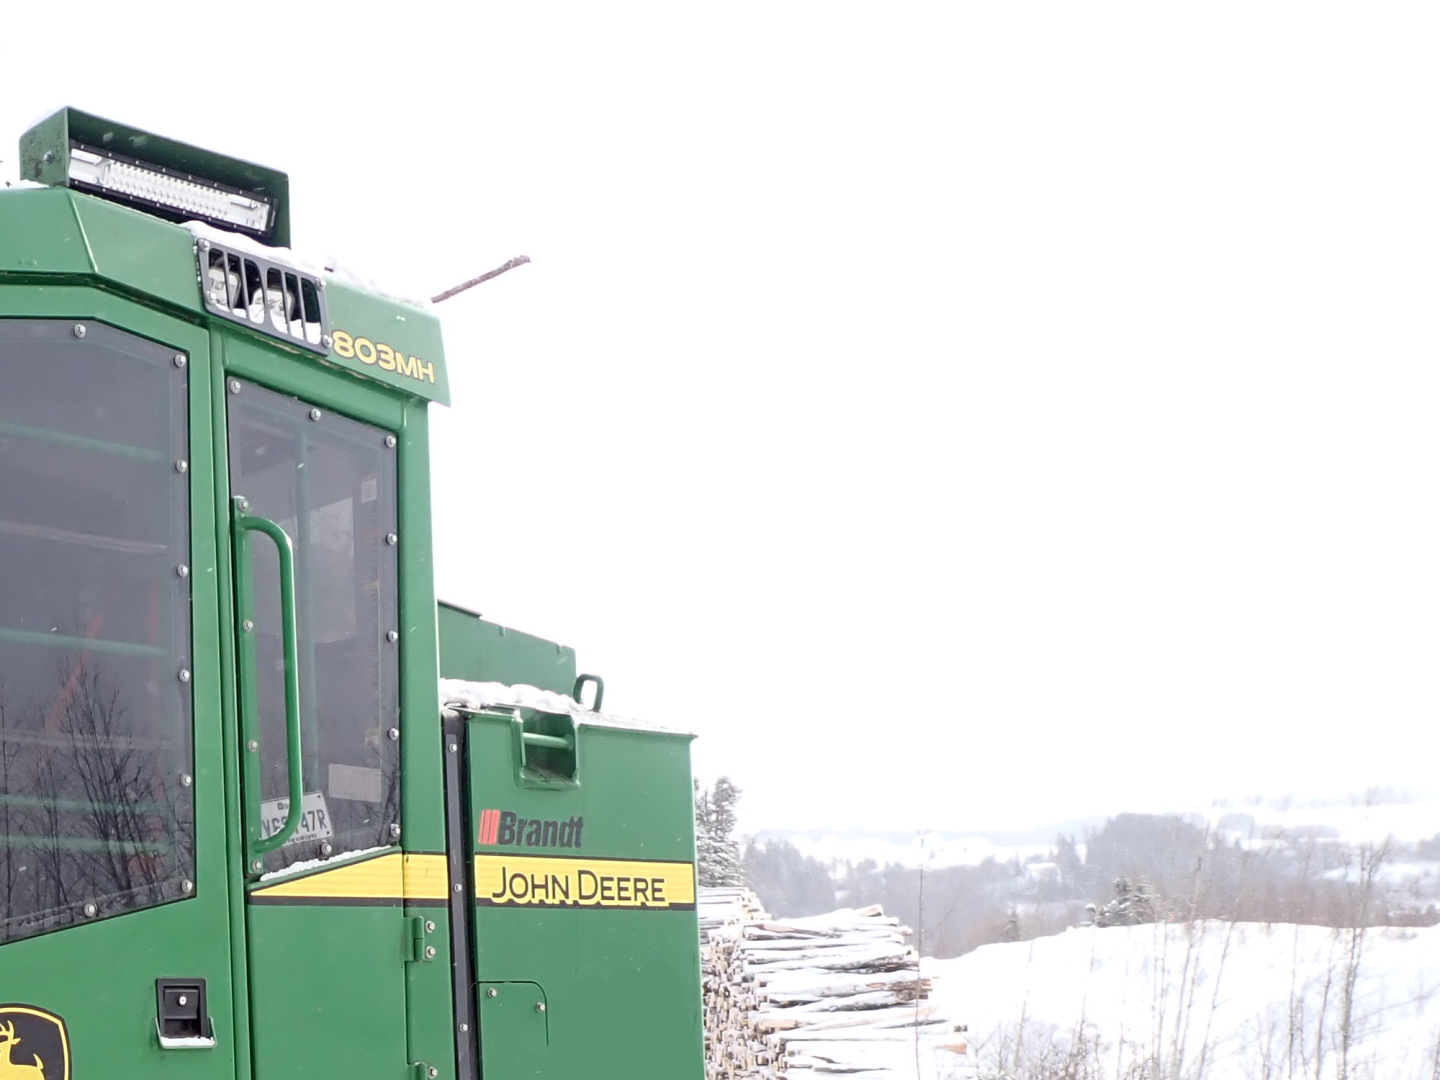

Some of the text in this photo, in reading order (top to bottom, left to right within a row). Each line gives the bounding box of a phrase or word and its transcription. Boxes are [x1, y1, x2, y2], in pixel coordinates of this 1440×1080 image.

[331, 330, 435, 384] 803MH
[498, 811, 584, 848] Brandt
[492, 866, 666, 902] JOHN DEERE
